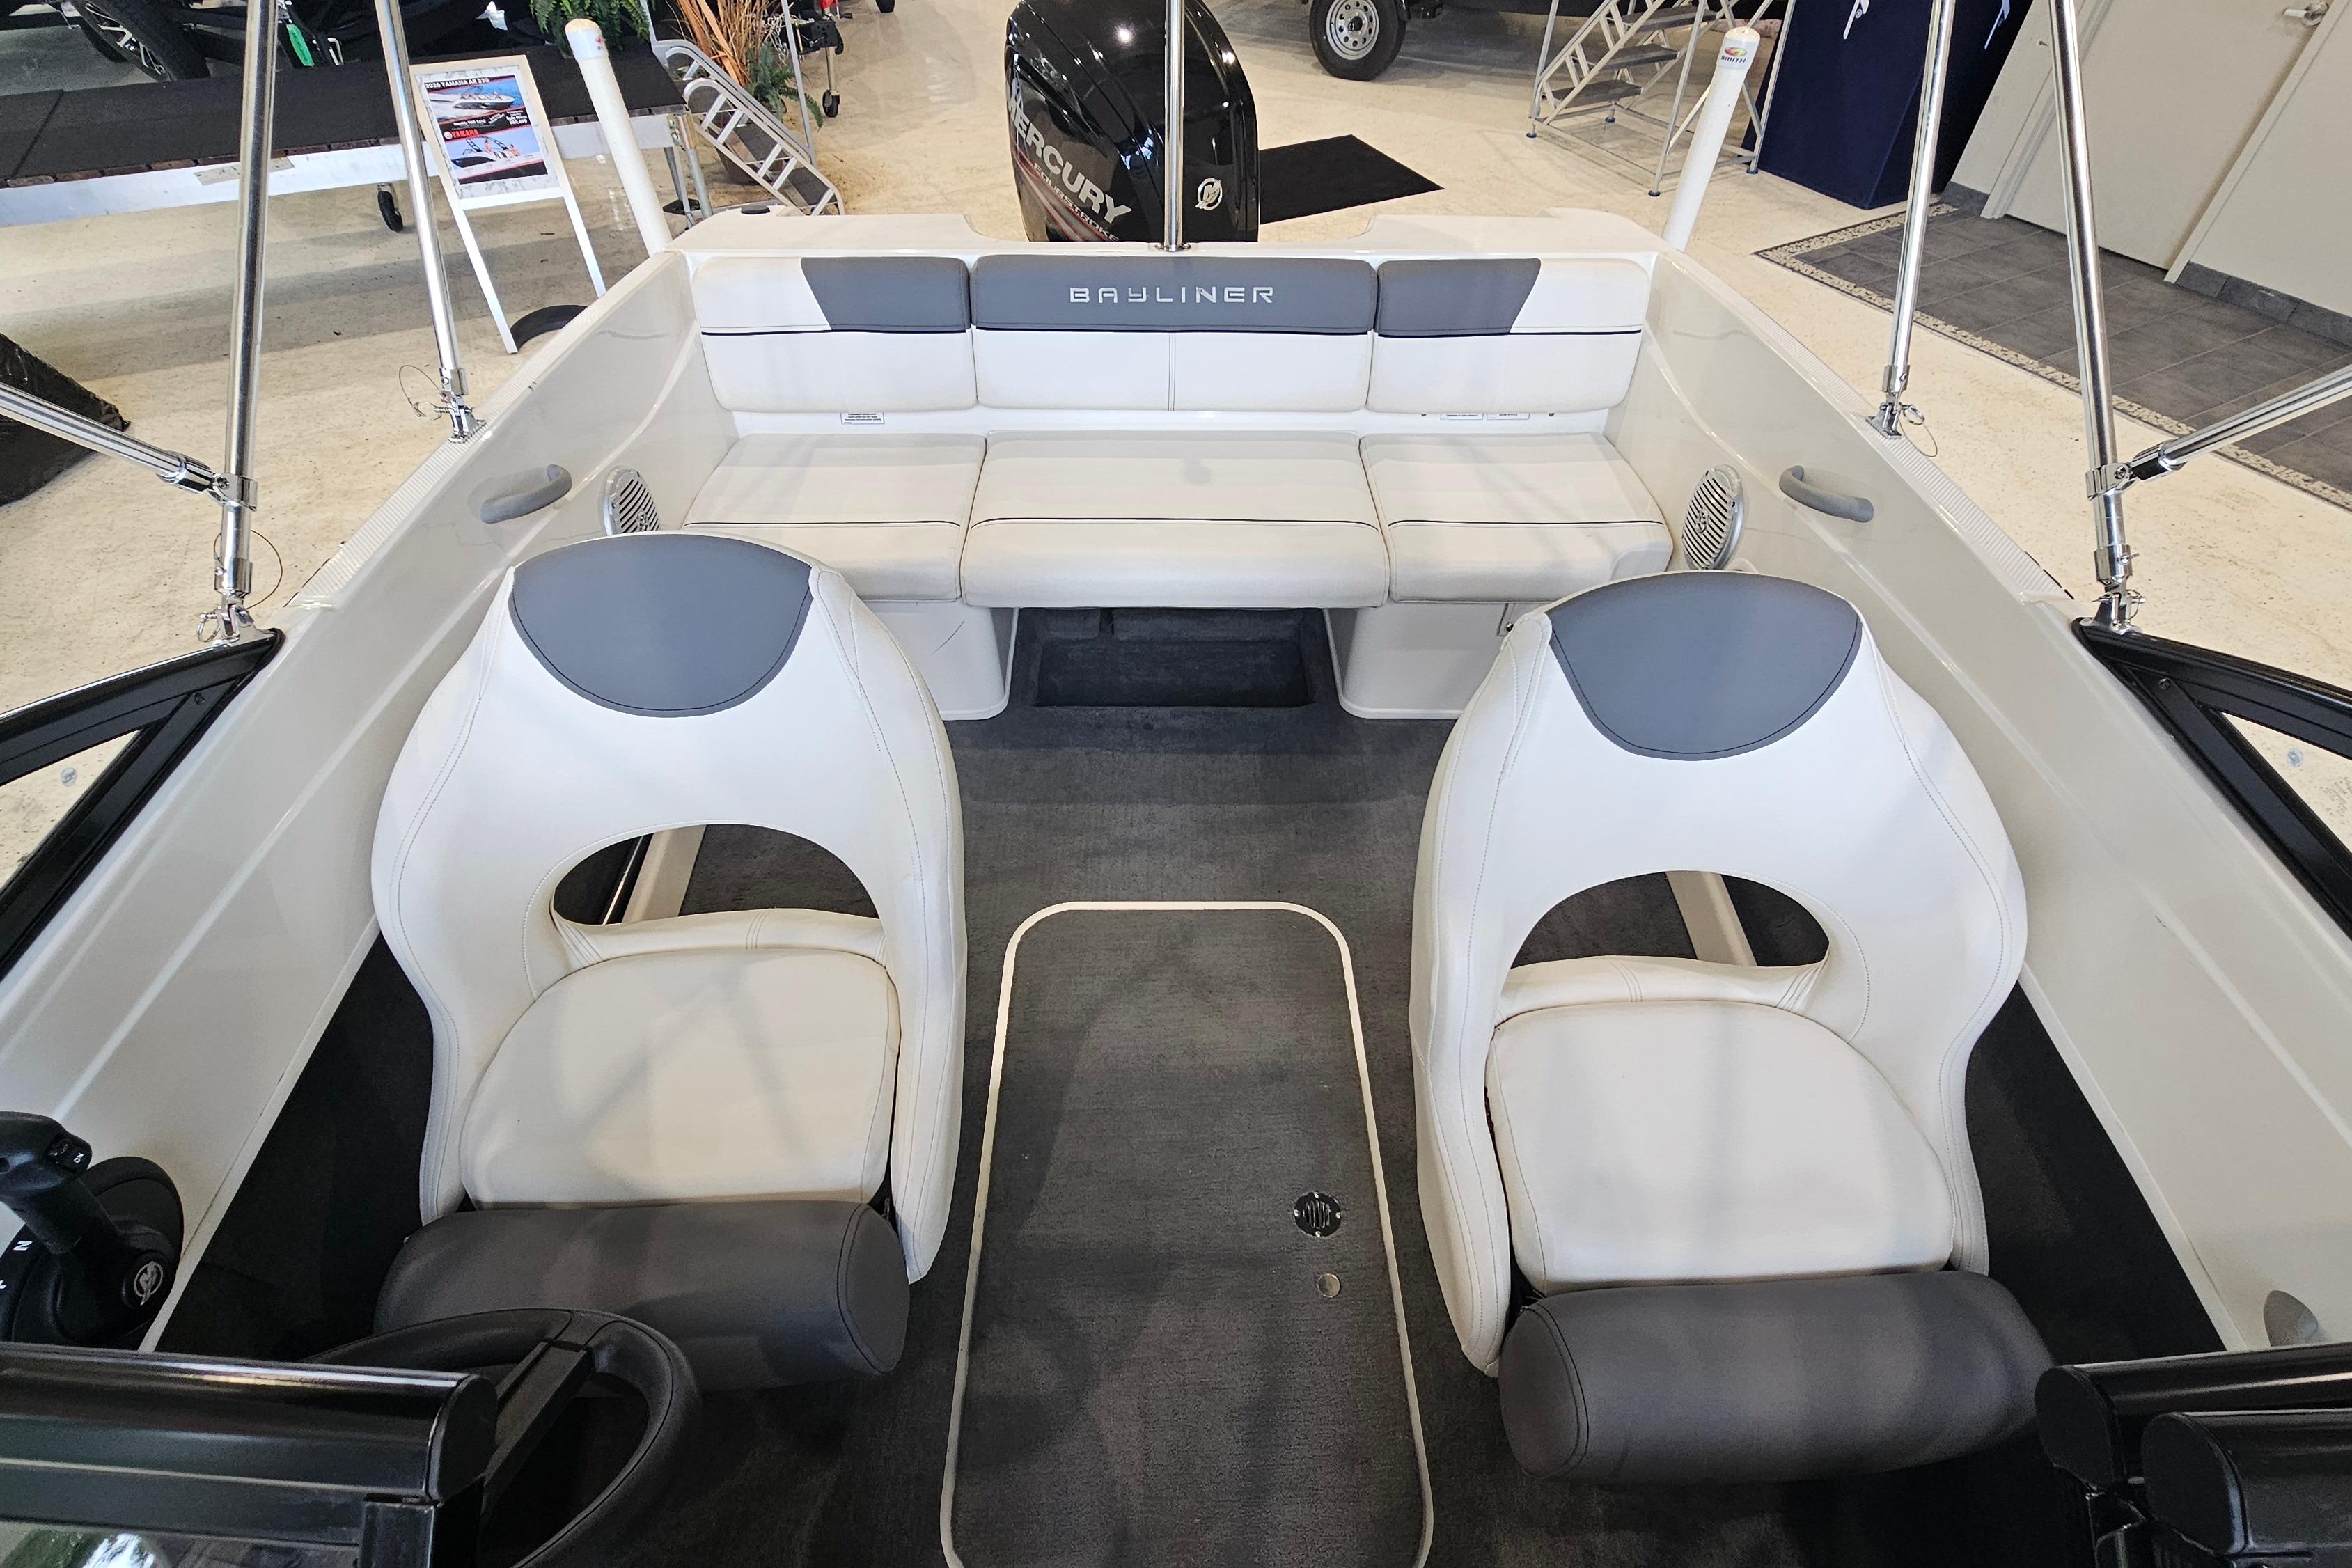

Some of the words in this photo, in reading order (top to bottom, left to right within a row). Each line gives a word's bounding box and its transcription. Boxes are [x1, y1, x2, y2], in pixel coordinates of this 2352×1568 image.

[1720, 55, 1746, 63] SMITH
[441, 79, 468, 88] YAMAHA
[452, 128, 480, 139] YAMAHA
[1008, 96, 1132, 224] MERCURY
[1034, 162, 1120, 242] FOURSTROKE
[1069, 286, 1274, 304] BAYLINER
